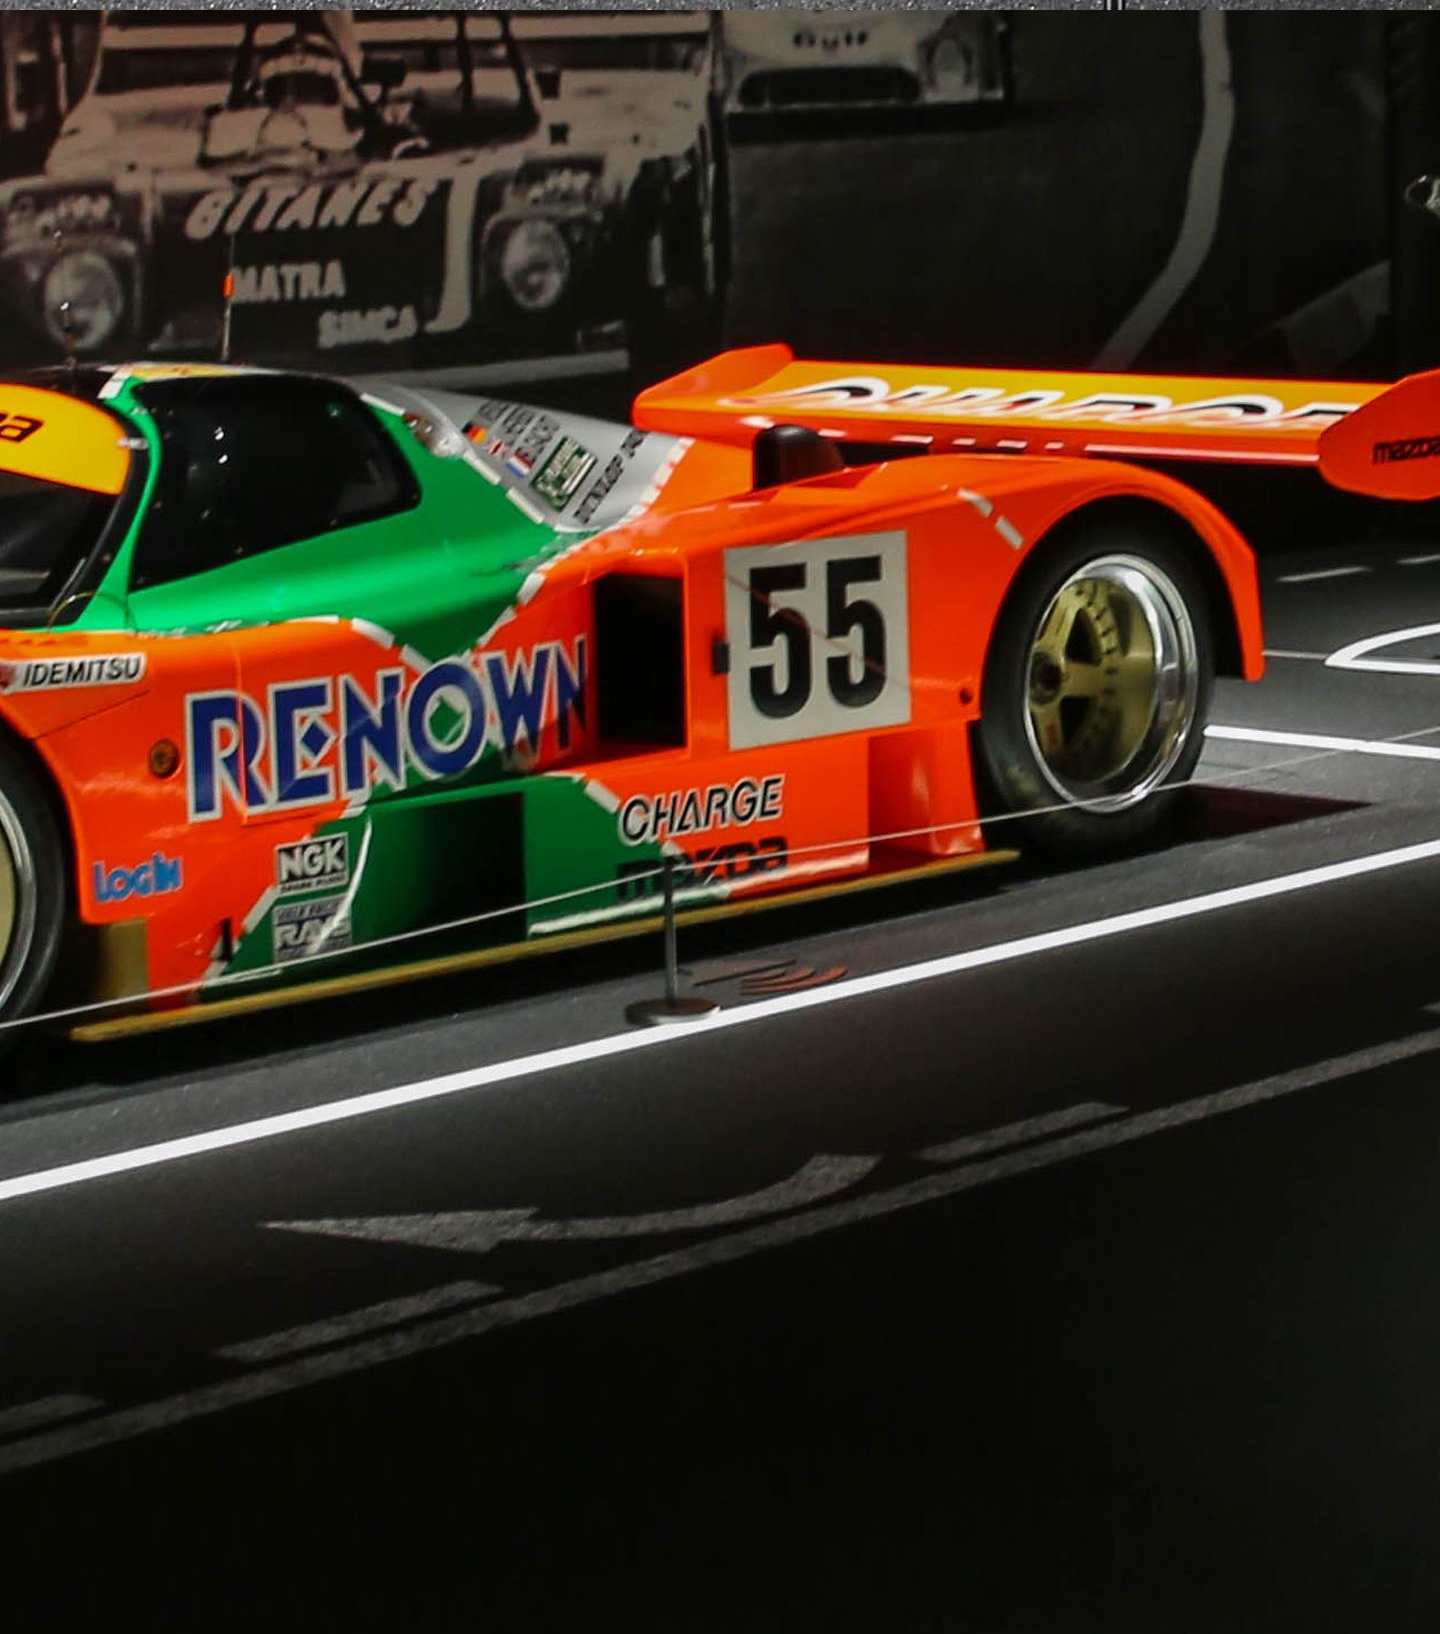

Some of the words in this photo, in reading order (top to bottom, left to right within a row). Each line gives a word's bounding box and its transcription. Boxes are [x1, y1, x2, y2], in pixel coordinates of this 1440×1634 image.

[228, 261, 346, 305] MATRA
[748, 558, 888, 719] 55
[22, 656, 142, 688] IDEMITSU
[185, 636, 589, 824] RENOWN
[617, 774, 786, 847] CHARGE
[278, 838, 346, 883] NGK
